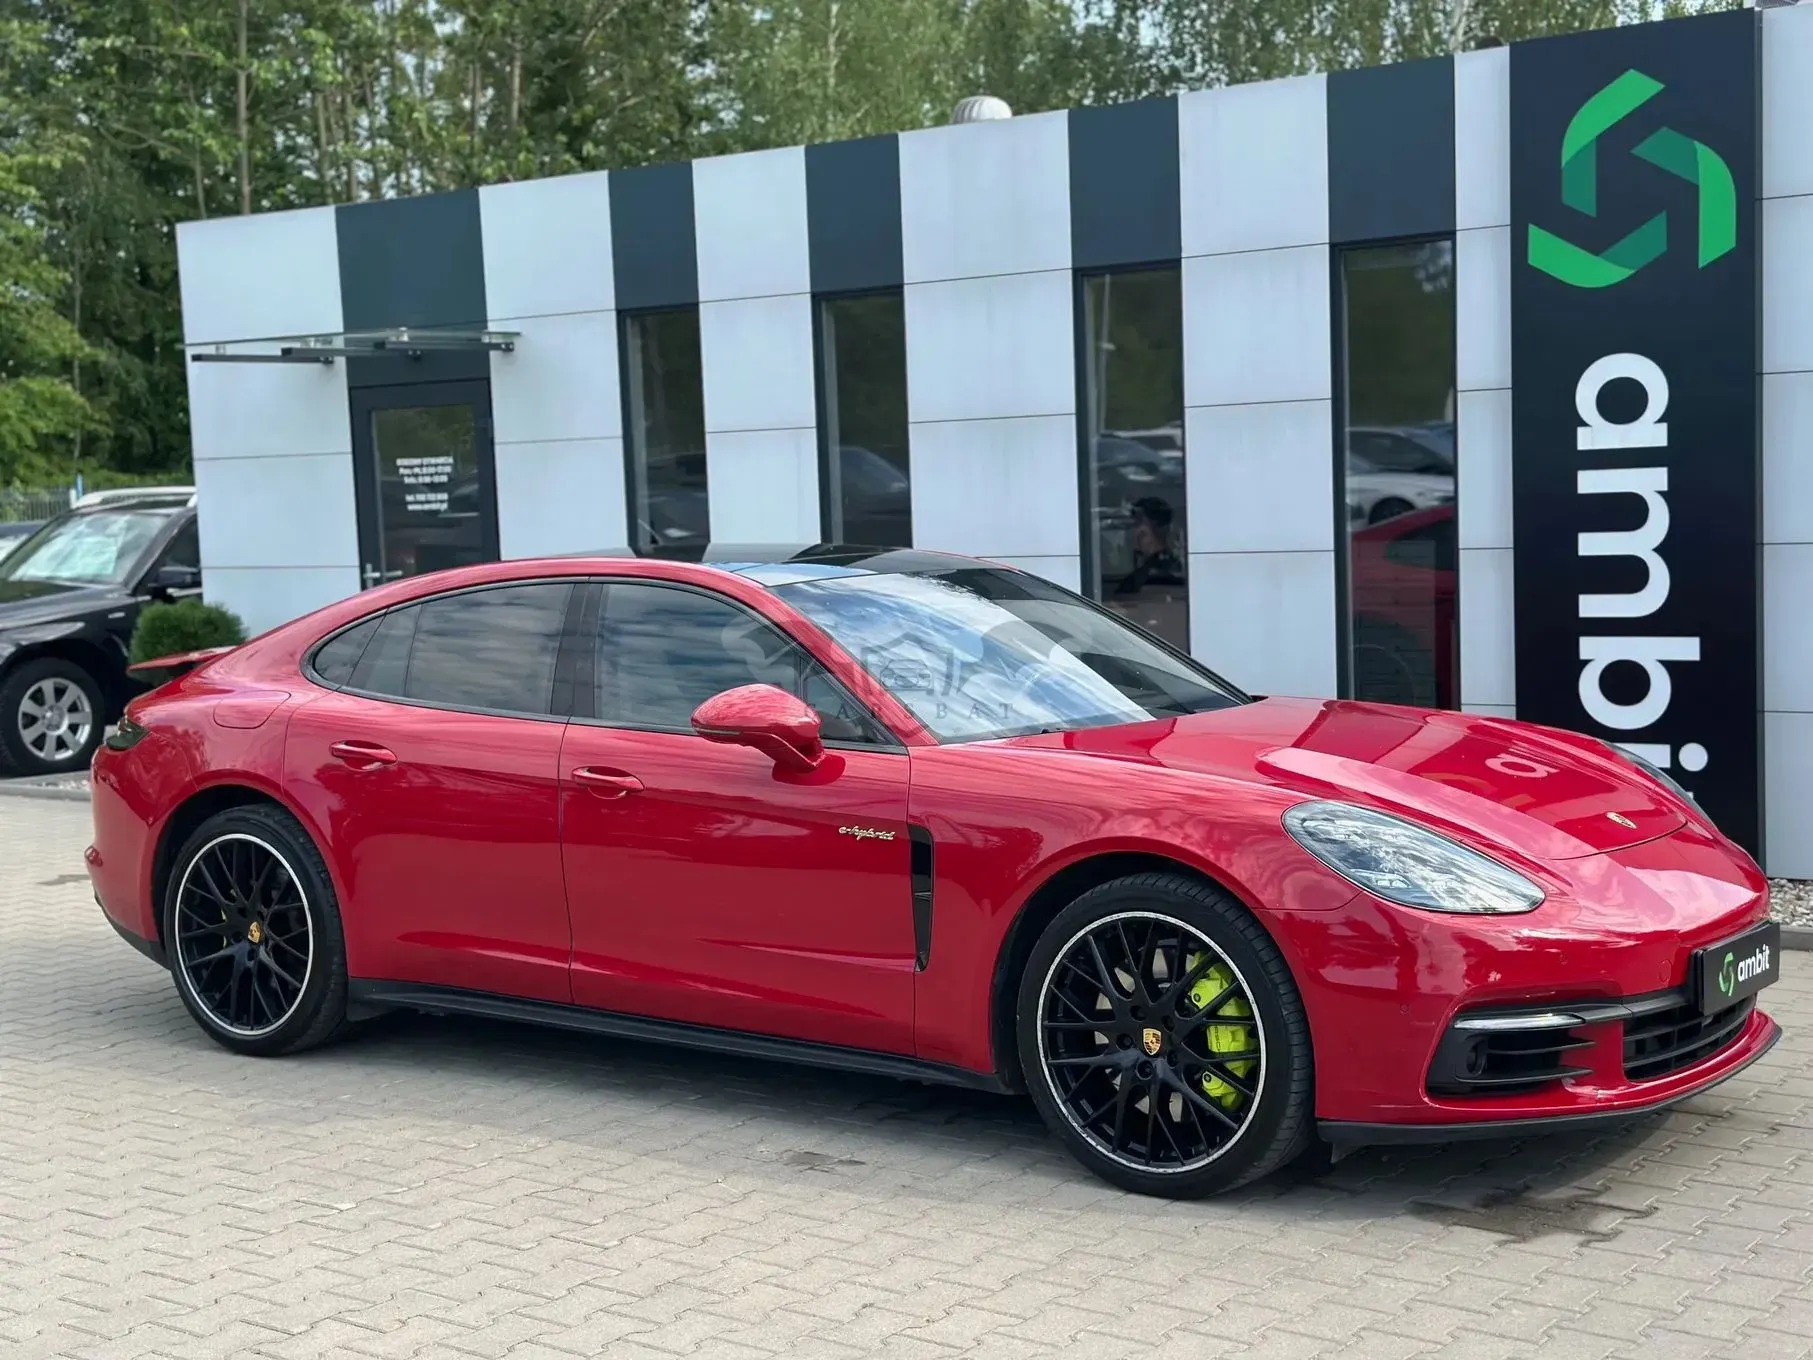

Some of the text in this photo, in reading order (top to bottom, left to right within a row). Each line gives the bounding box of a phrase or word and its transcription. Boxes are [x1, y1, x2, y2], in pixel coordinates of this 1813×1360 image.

[1575, 352, 1709, 800] ambi
[838, 825, 896, 841] e-hybrid
[1737, 943, 1770, 983] ambit
